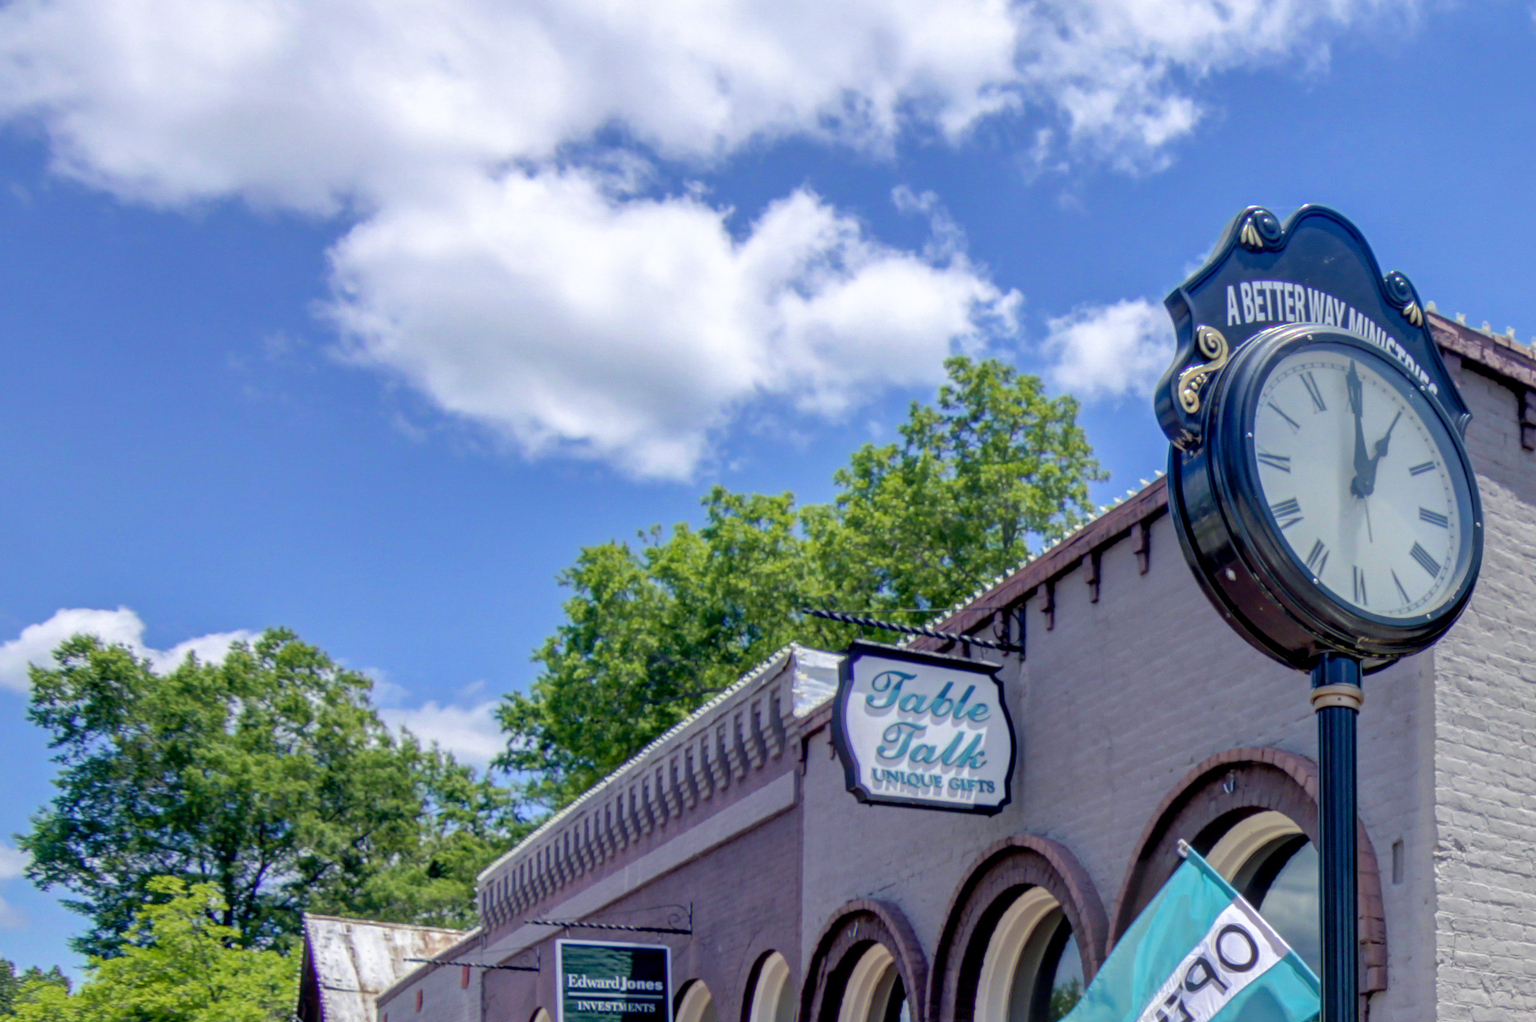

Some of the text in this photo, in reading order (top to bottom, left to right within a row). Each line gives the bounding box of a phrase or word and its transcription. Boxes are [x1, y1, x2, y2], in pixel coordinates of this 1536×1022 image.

[1226, 285, 1241, 327] A
[1239, 280, 1307, 324] BETTER
[1307, 287, 1346, 328] WAY
[866, 670, 991, 722] Table
[876, 721, 987, 770] Talk
[872, 768, 995, 794] UNIQUE GIFTS
[577, 1001, 656, 1013] INVESTMENTS
